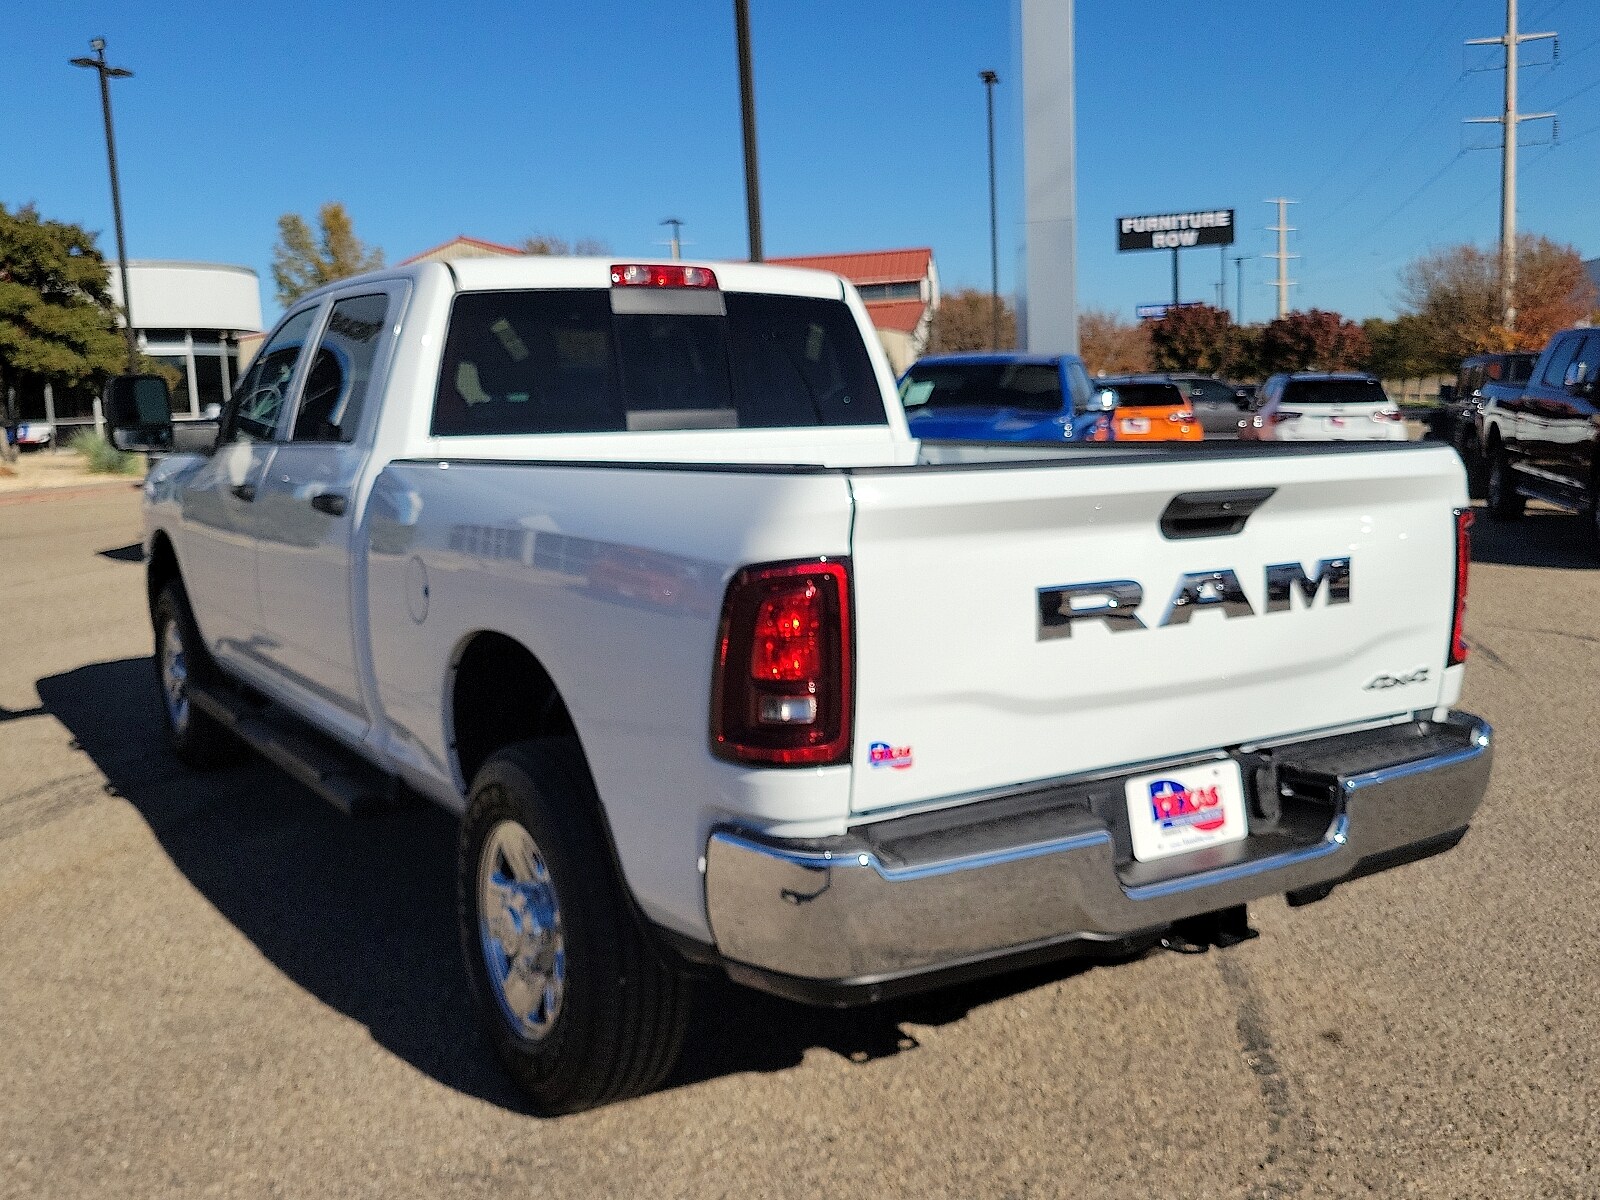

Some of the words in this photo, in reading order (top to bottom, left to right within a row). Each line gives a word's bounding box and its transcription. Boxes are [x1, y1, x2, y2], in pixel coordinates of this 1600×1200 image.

[1121, 211, 1231, 234] FURNITURE
[1151, 230, 1200, 248] ROW
[1036, 556, 1352, 642] RAM
